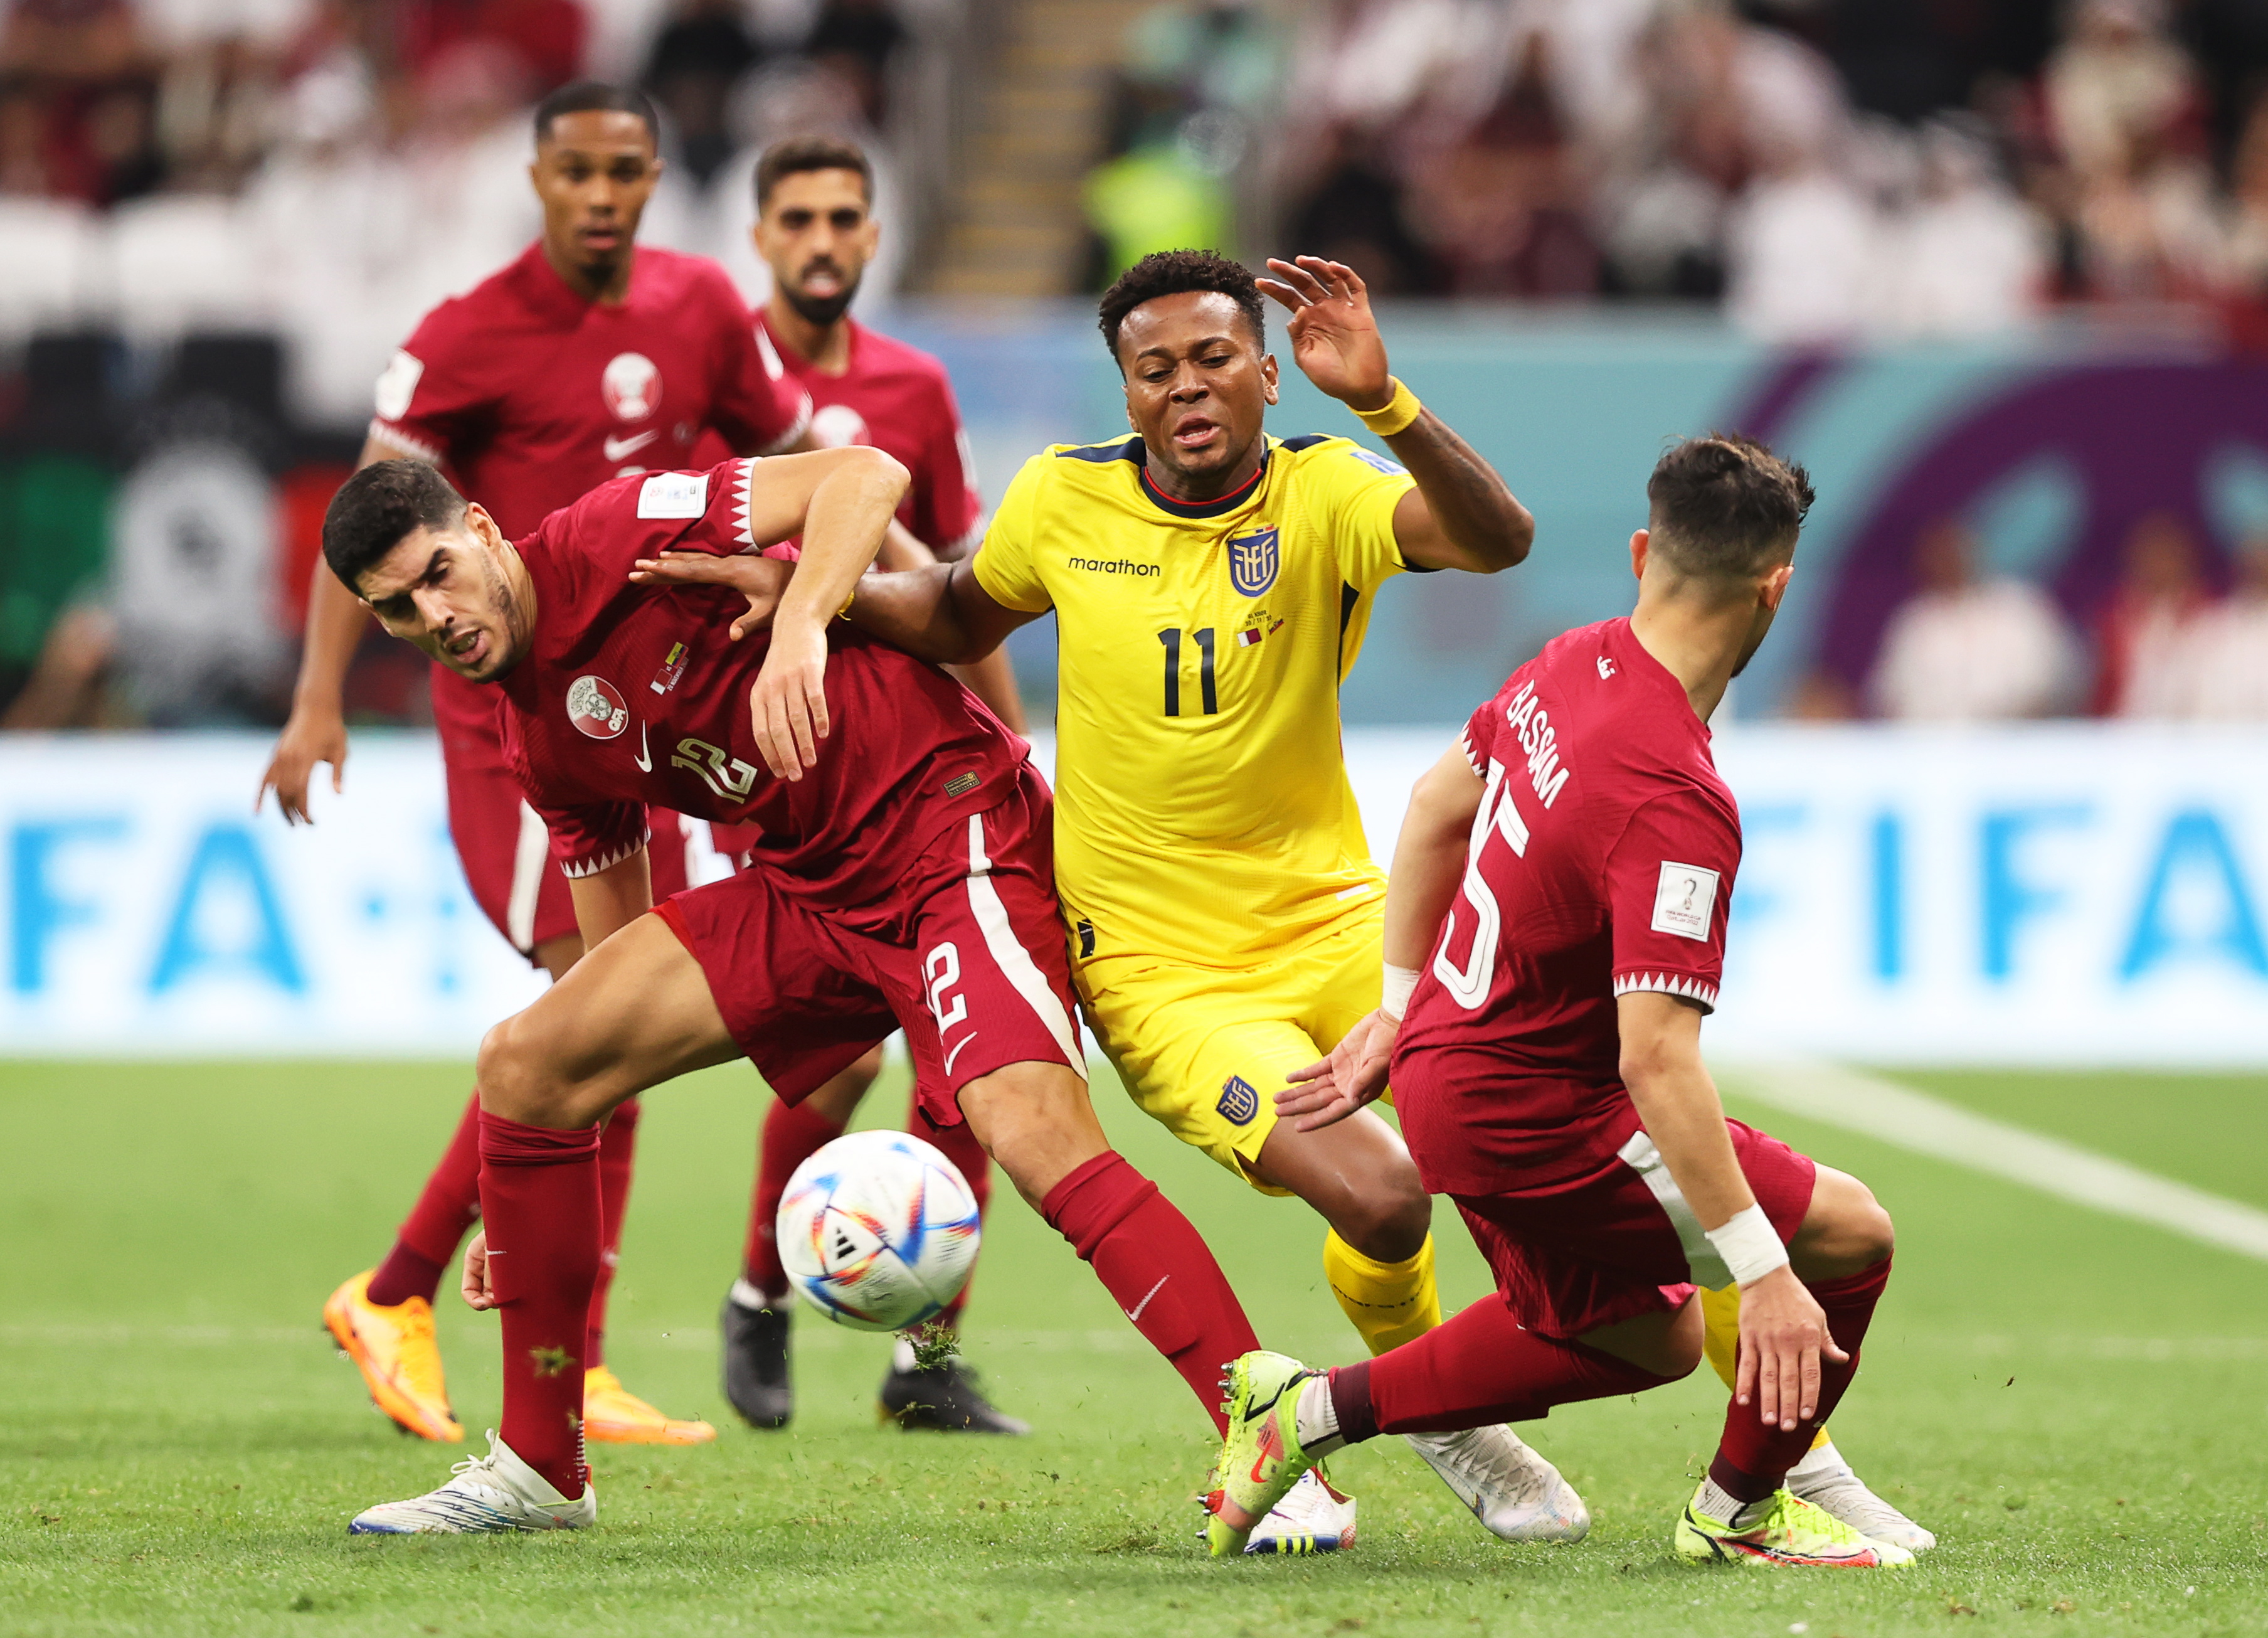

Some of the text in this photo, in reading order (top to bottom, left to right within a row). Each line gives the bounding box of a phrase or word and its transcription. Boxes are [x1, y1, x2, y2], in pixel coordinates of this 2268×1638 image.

[1068, 557, 1160, 577] marathon
[1157, 628, 1218, 716] 11
[671, 738, 758, 804] 12
[1506, 679, 1570, 810] BASSAM
